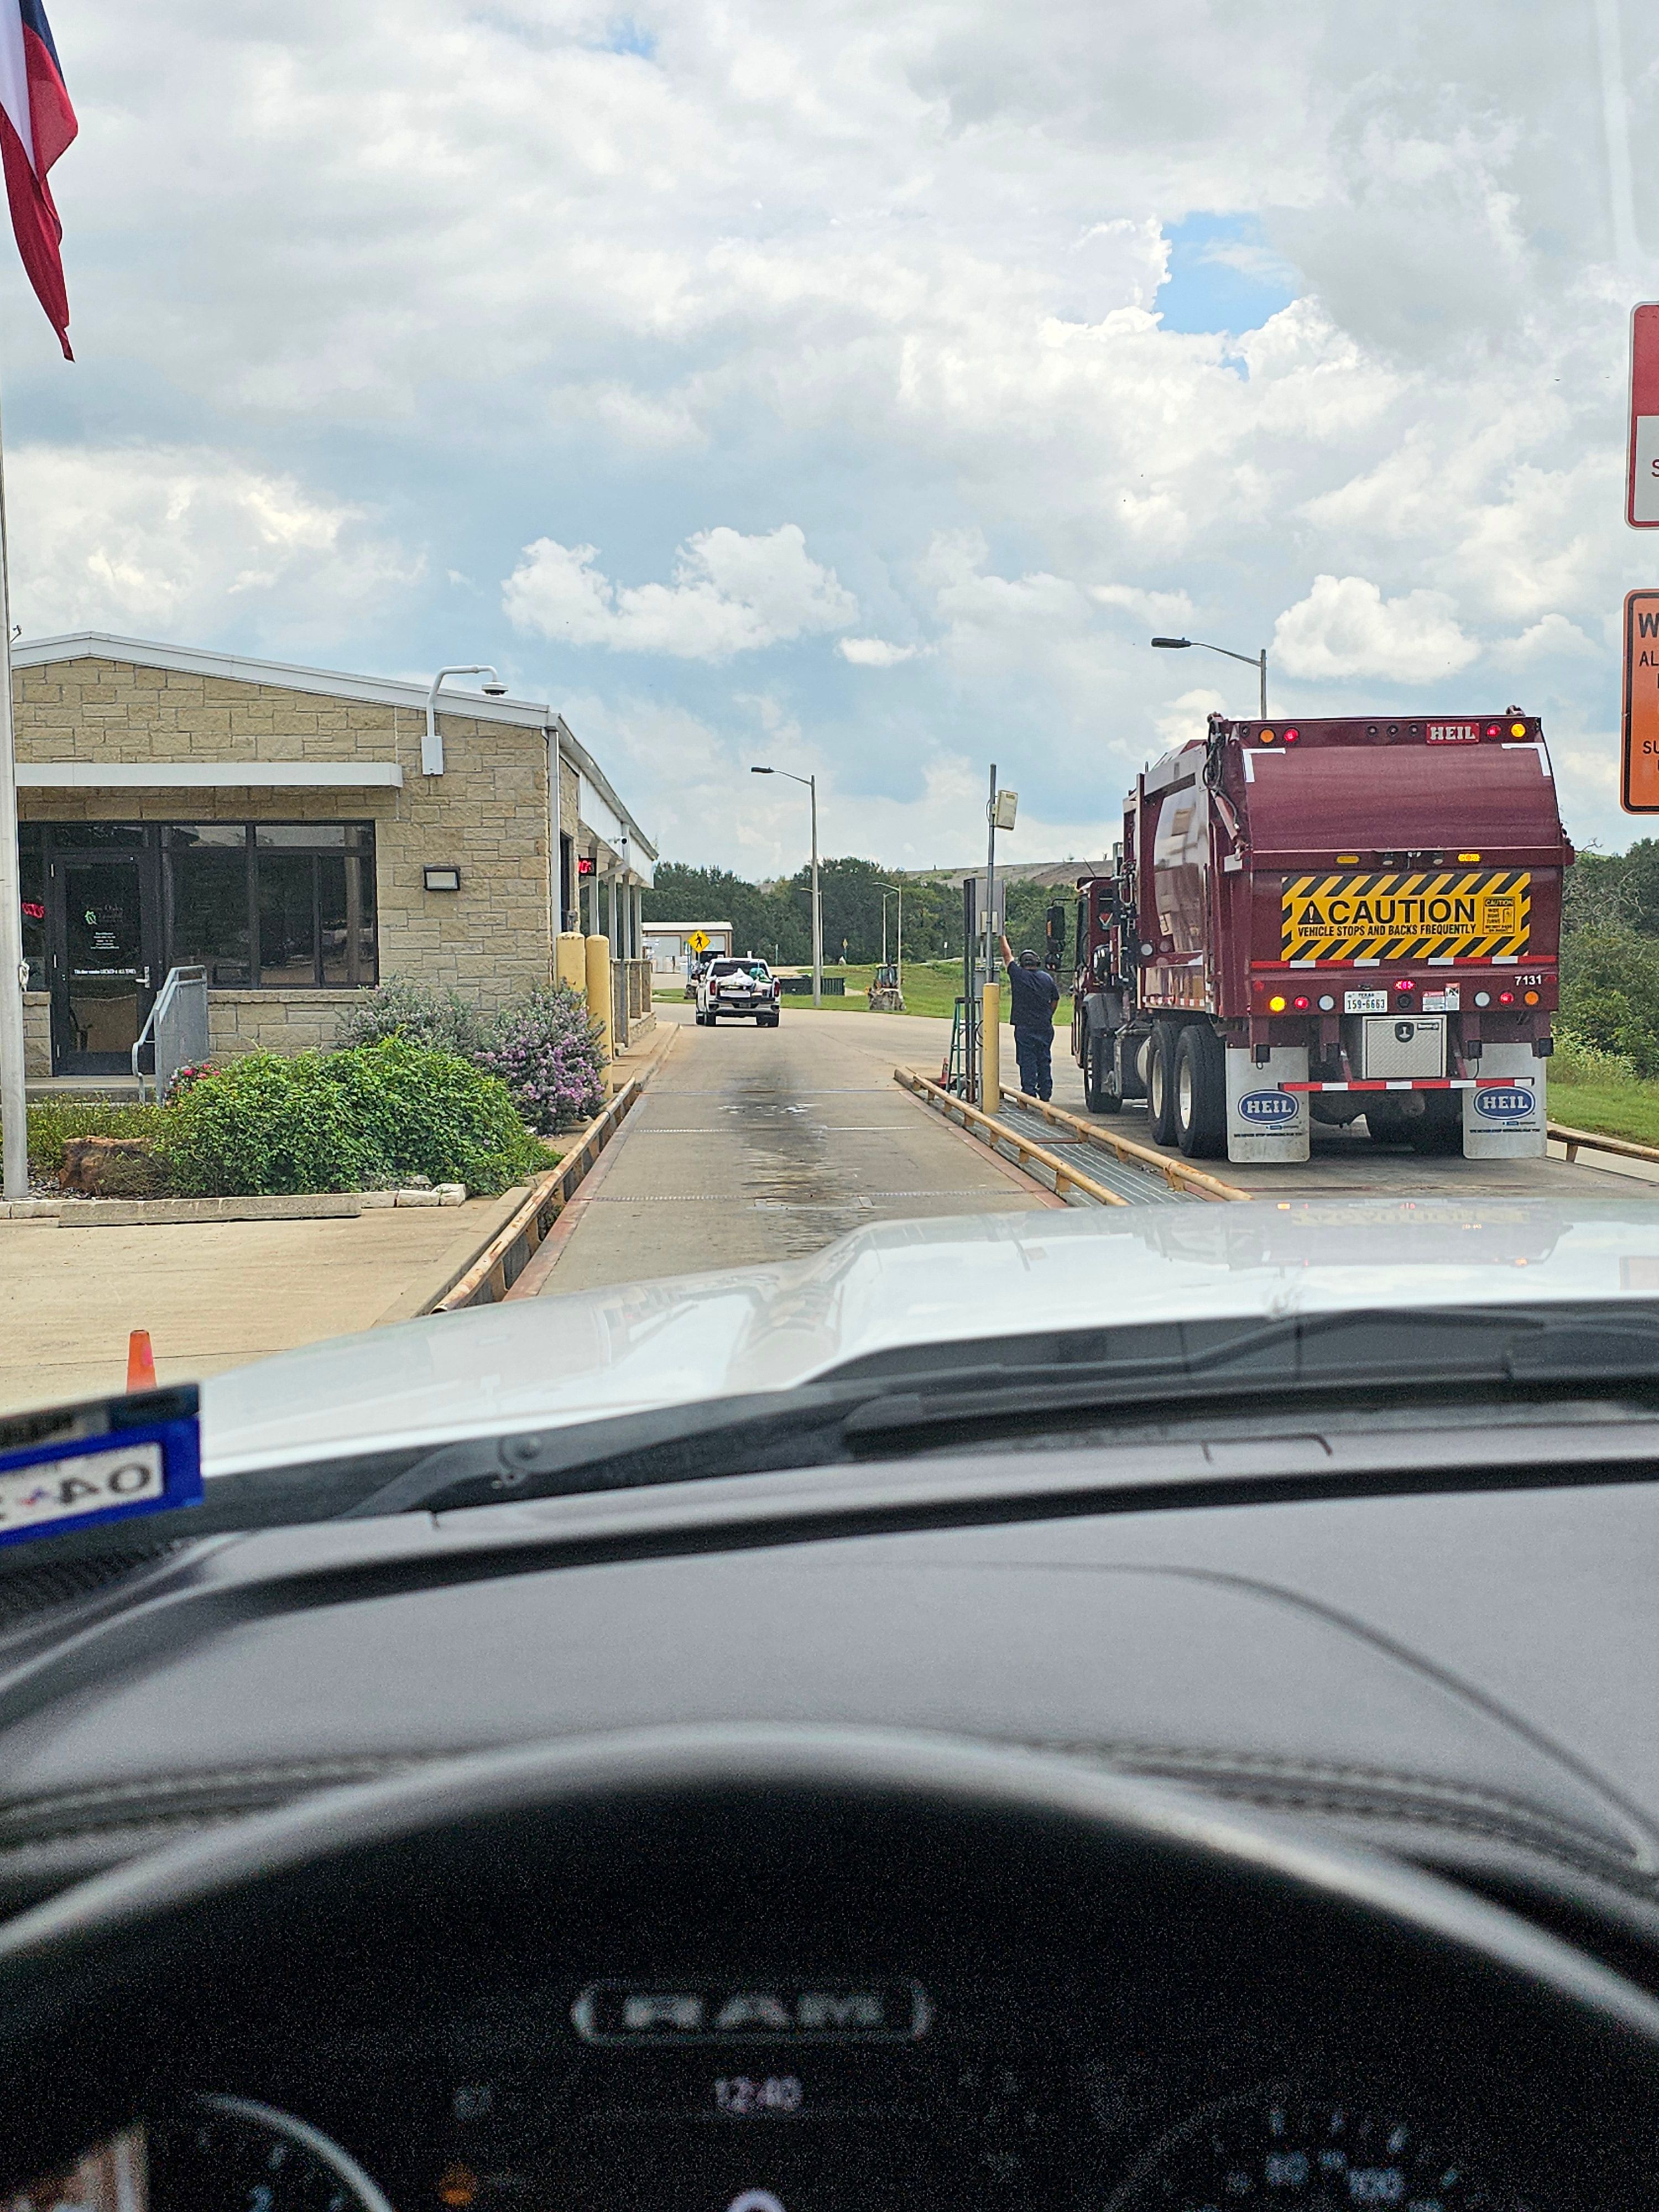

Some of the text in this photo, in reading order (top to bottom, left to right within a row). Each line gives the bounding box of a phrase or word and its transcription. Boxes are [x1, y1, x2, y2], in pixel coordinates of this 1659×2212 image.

[1430, 726, 1476, 740] HEIL
[1328, 898, 1475, 924] CAUTION
[1298, 924, 1476, 937] VEHICLE STOPS AND BACKS FREQUENTLY
[1514, 974, 1542, 986] 7131
[1246, 1100, 1292, 1113] HEIL
[1483, 1096, 1529, 1109] HEIL
[623, 1994, 883, 2028] RAM
